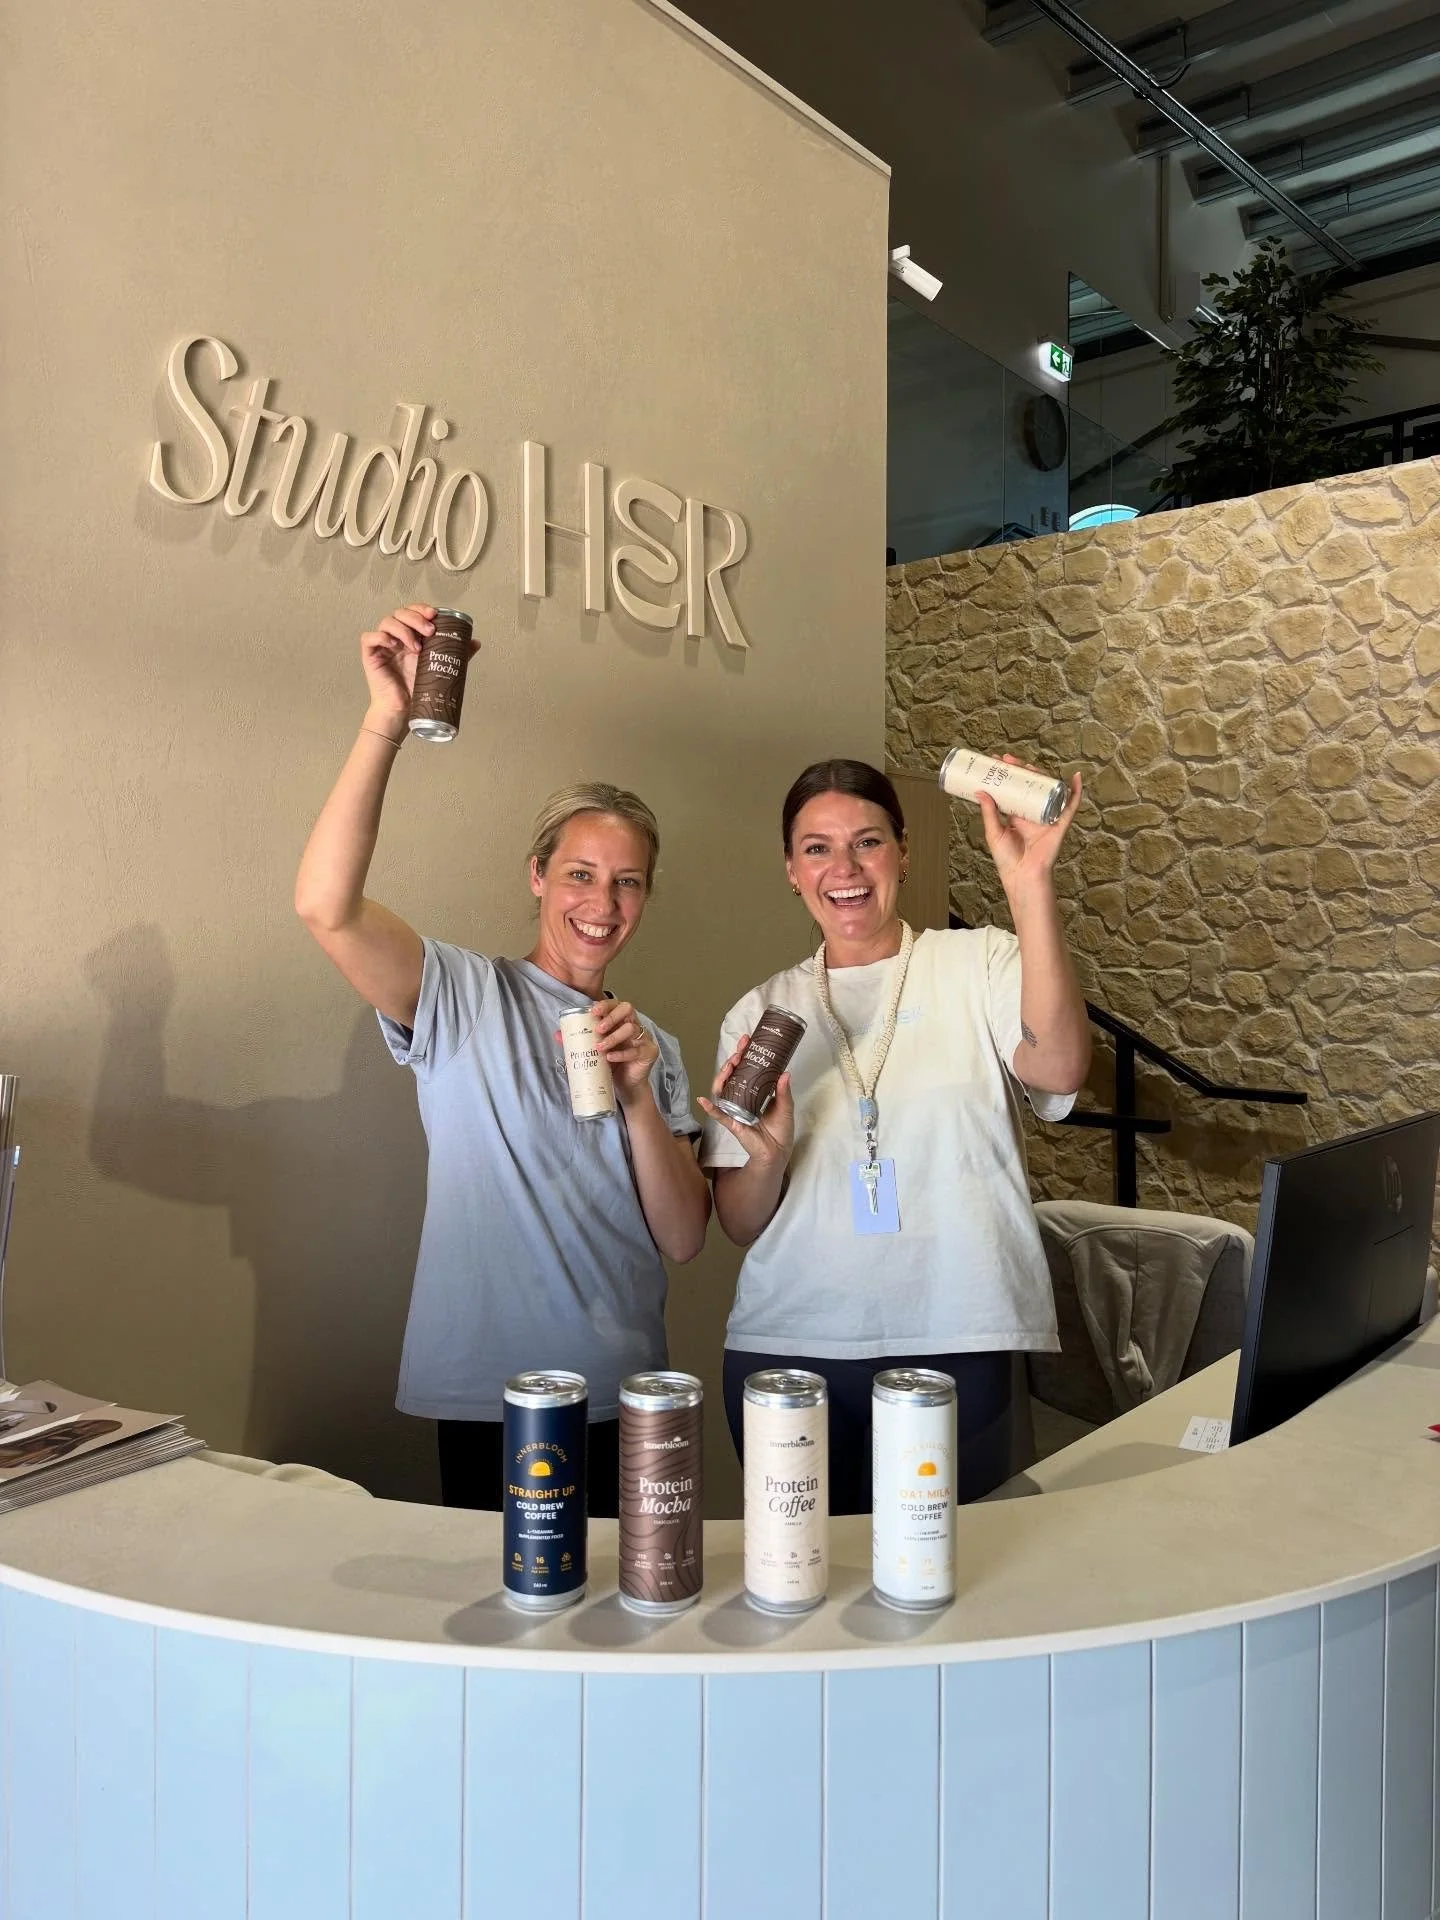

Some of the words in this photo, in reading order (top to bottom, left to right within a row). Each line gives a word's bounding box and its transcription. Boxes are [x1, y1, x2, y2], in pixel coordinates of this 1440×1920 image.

[148, 334, 489, 572] Studio
[523, 440, 751, 649] HER
[429, 650, 461, 667] Protein
[428, 661, 459, 677] Mocha
[745, 1050, 771, 1068] Mocha
[749, 1041, 776, 1060] Protein
[515, 1442, 568, 1464] INNERBLOOM
[508, 1484, 560, 1499] STRAIGHT
[562, 1485, 576, 1497] UP
[639, 1476, 693, 1495] Protein
[765, 1475, 819, 1494] Protein
[899, 1488, 923, 1498] OAT
[927, 1487, 952, 1499] MILK
[516, 1501, 538, 1511] COLD
[540, 1502, 564, 1511] BREW
[638, 1496, 691, 1515] Mocha
[768, 1494, 816, 1518] Coffee
[901, 1504, 925, 1512] COLD
[927, 1501, 948, 1511] BREW
[524, 1511, 557, 1520] COFFEE
[911, 1512, 943, 1521] COFFEE
[535, 1556, 545, 1564] 16
